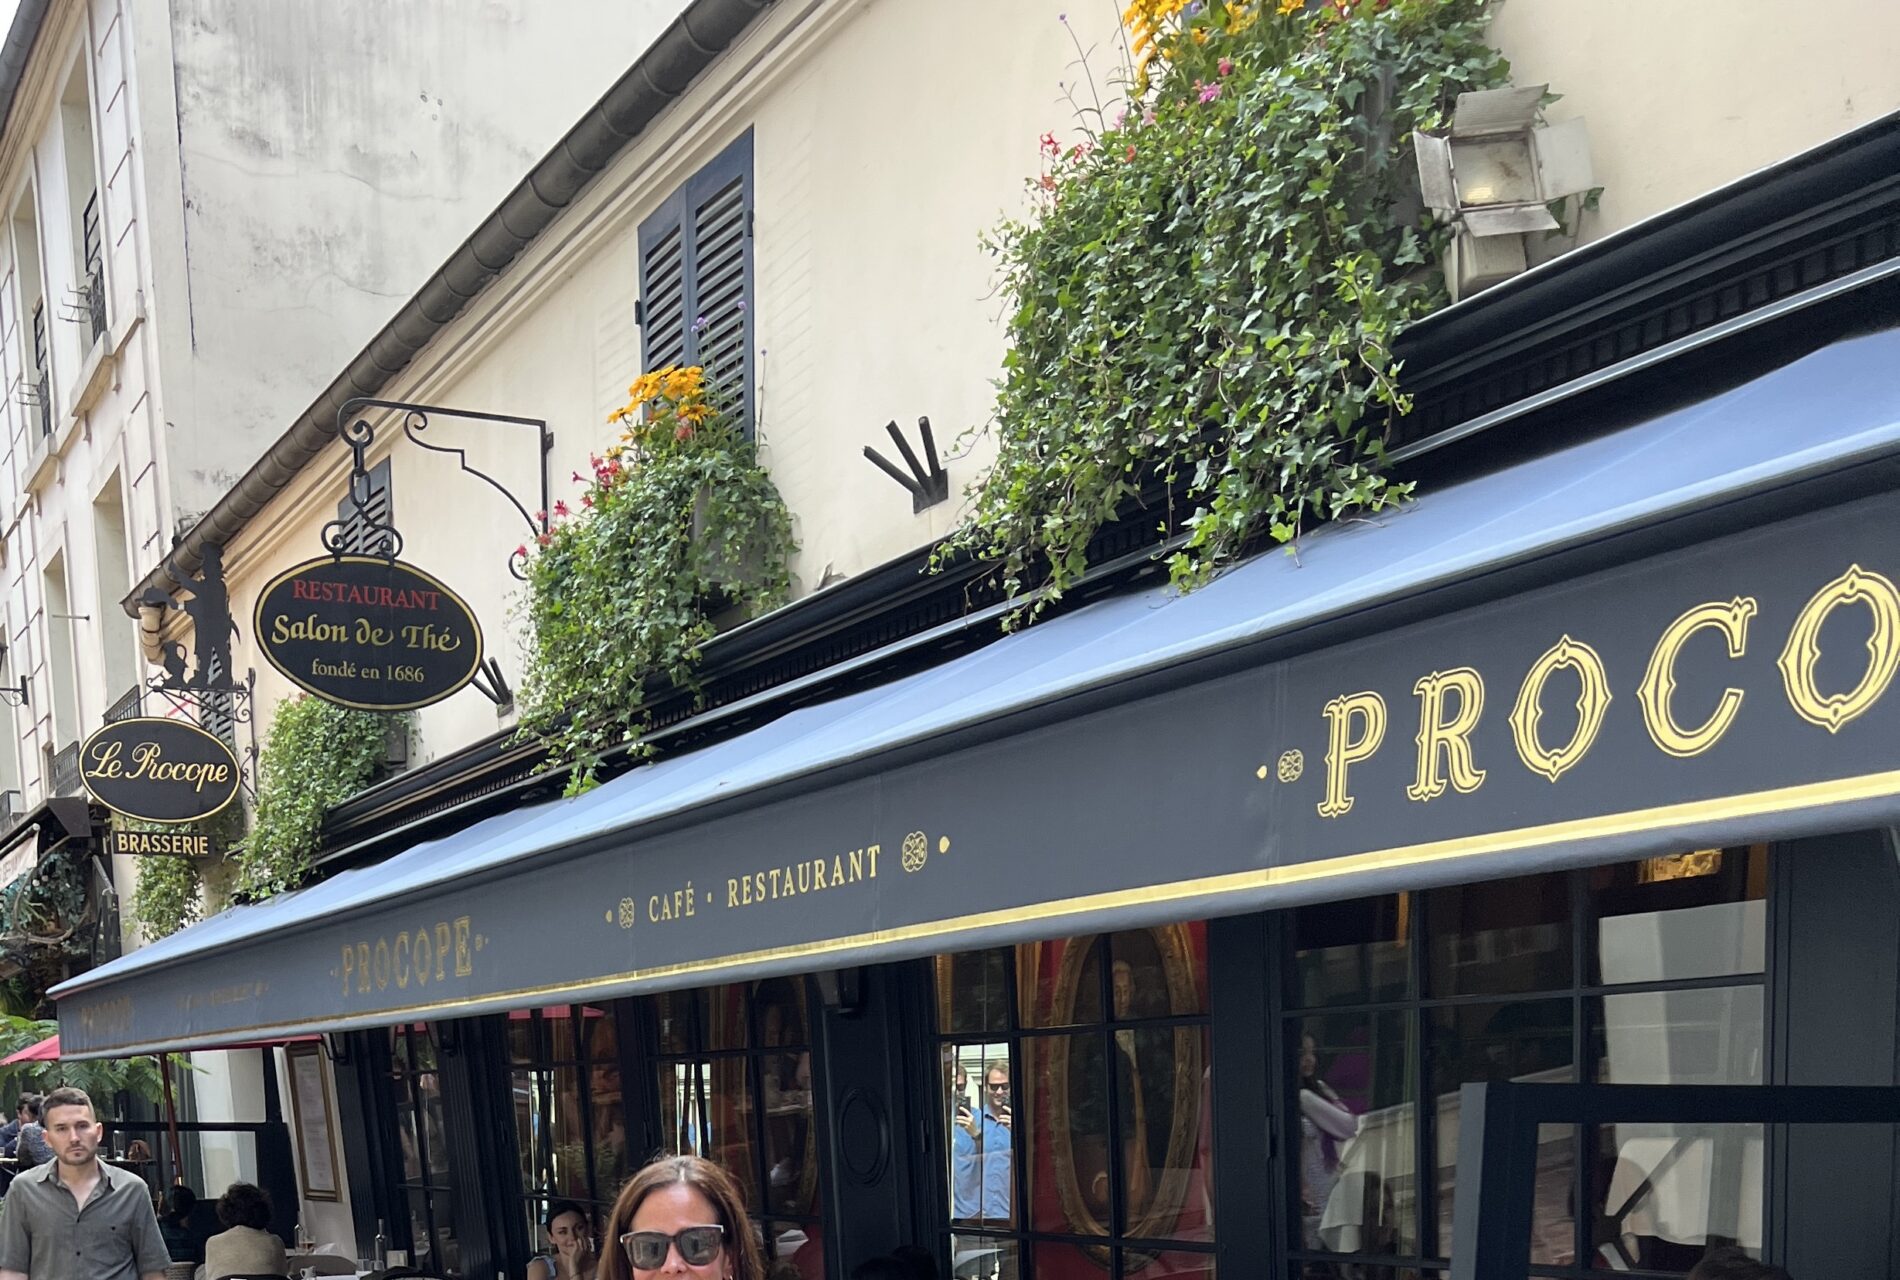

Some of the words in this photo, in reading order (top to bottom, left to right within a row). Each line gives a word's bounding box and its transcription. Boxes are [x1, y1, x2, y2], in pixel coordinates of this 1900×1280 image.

[293, 579, 441, 611] RESTAURANT
[272, 613, 349, 644] Salon
[355, 617, 395, 646] de
[401, 623, 461, 652] Thé
[312, 657, 356, 678] fondé
[361, 668, 380, 680] en
[387, 664, 425, 683] 1686
[1317, 563, 1900, 819] PROCO
[85, 741, 123, 779] Le
[125, 741, 229, 793] Procope
[117, 833, 209, 856] BRASSERIE
[649, 881, 695, 923] CAFÉ
[728, 844, 881, 908] RESTAURANT
[341, 915, 472, 998] PROCOPE
